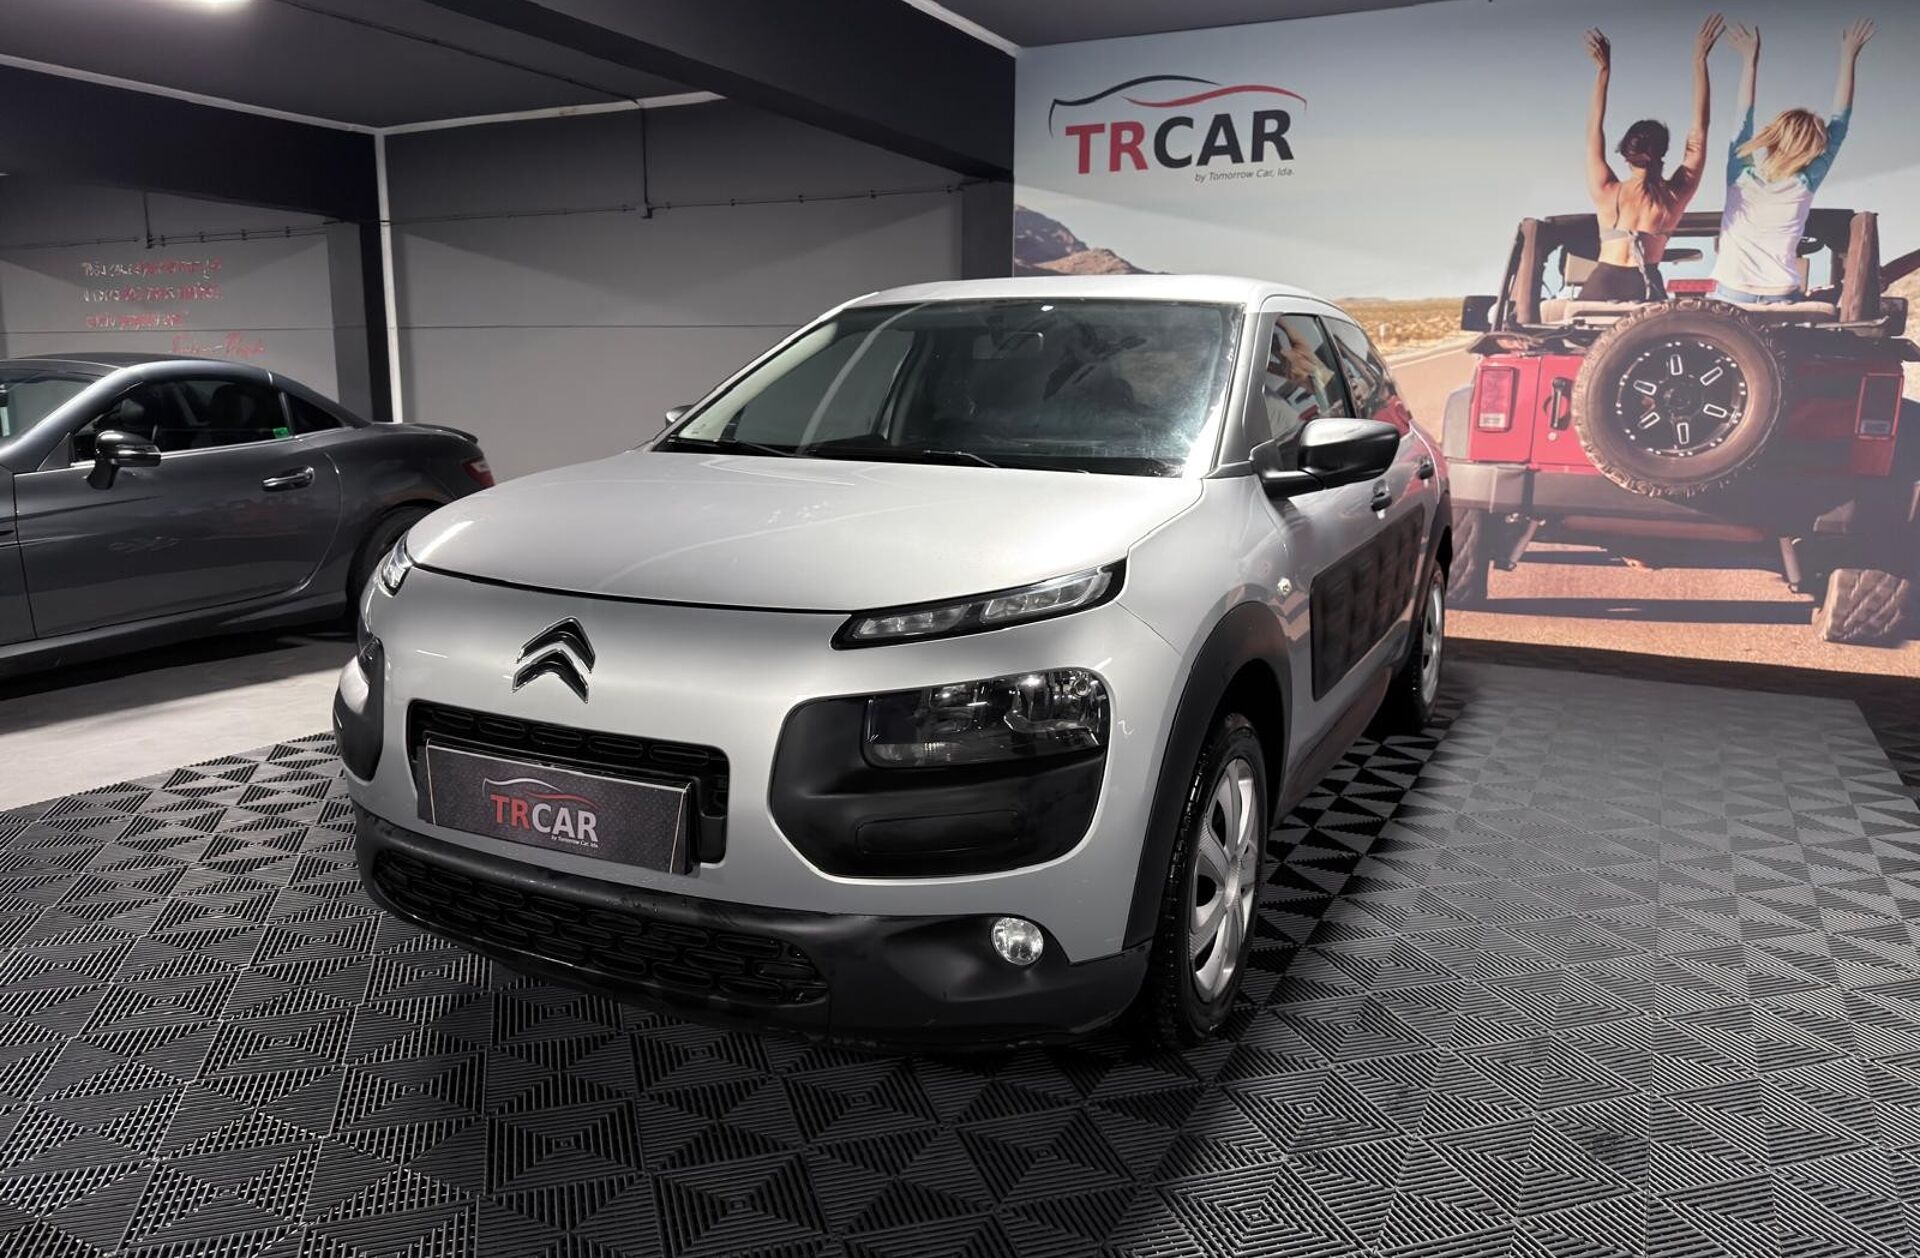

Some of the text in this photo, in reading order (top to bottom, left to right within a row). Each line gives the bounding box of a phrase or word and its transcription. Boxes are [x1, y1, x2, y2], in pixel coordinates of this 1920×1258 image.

[1065, 109, 1294, 174] TRCAR
[1194, 173, 1206, 183] by
[1209, 171, 1253, 181] Tomorrow
[490, 794, 599, 842] TRCAR
